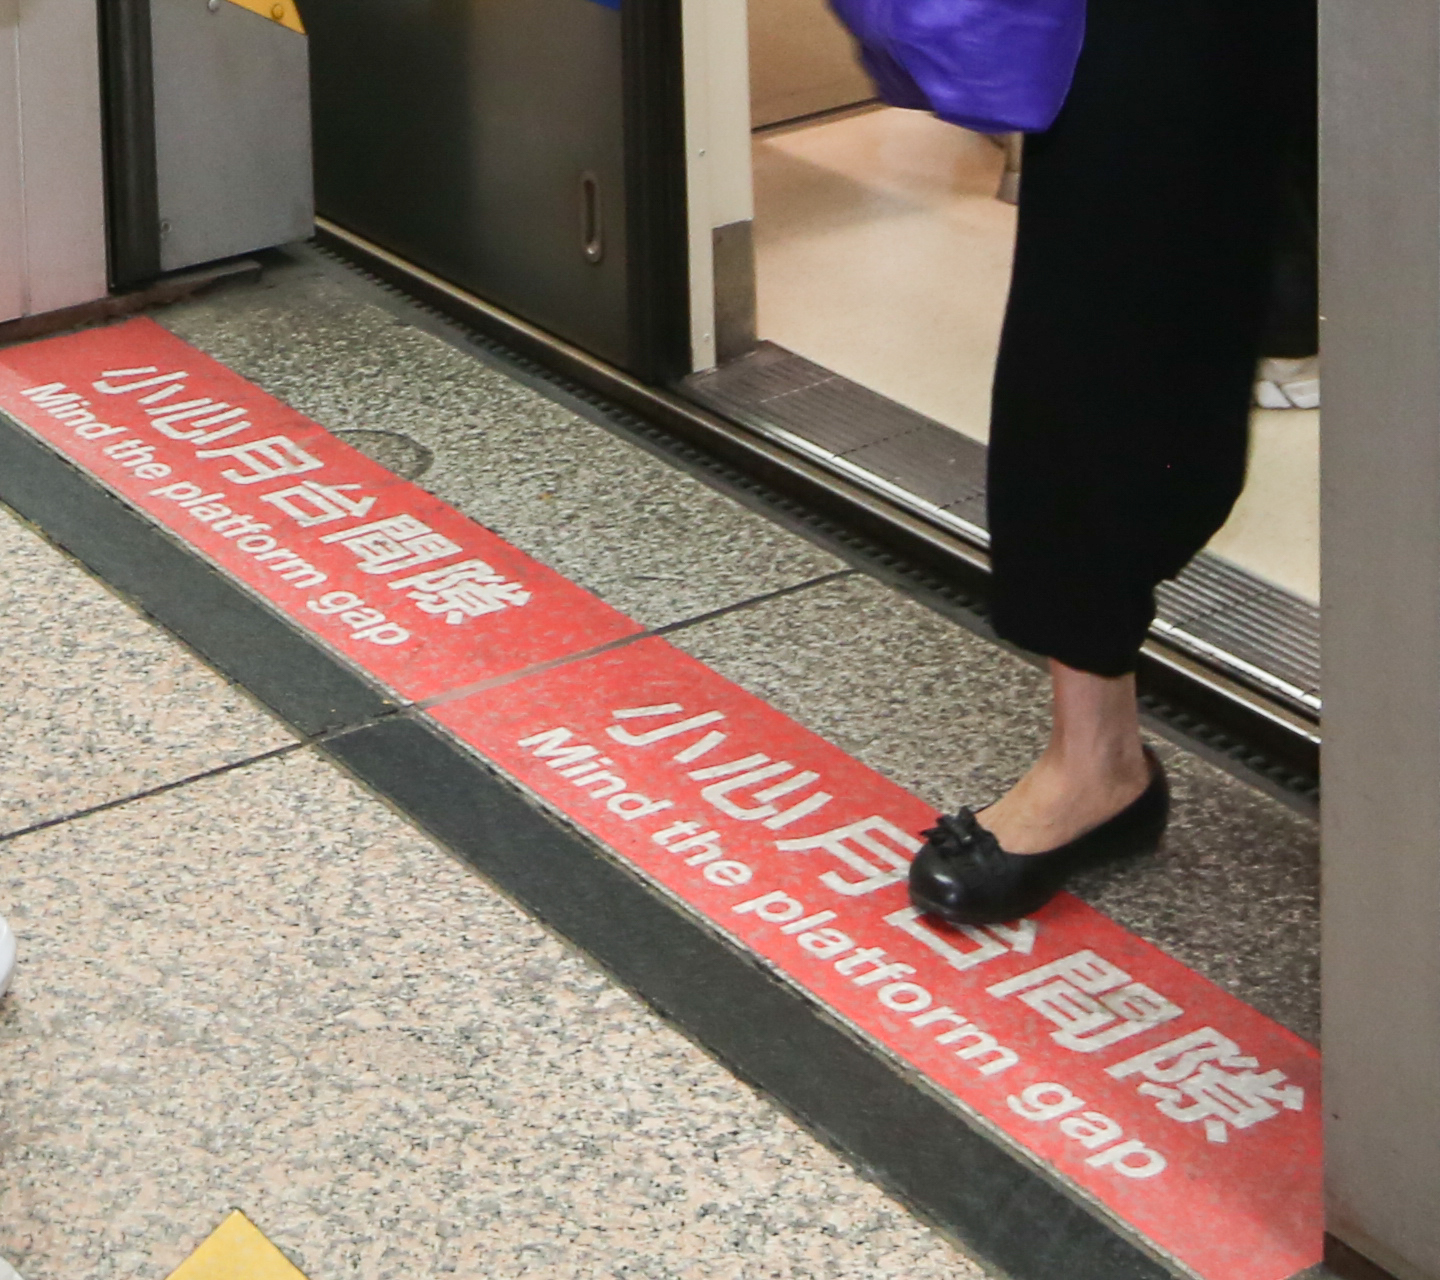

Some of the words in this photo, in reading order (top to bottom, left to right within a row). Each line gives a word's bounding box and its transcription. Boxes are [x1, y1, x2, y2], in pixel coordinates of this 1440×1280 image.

[20, 381, 113, 443] Mind
[102, 432, 174, 482] the
[149, 480, 330, 591] platform
[306, 591, 412, 646] gap
[91, 364, 533, 626] 小心月台間隙
[517, 724, 673, 822] Mind
[651, 817, 755, 888] the
[731, 889, 1020, 1077] platform
[1006, 1080, 1169, 1181] gap
[606, 701, 1306, 1144] 小心月台間隙
